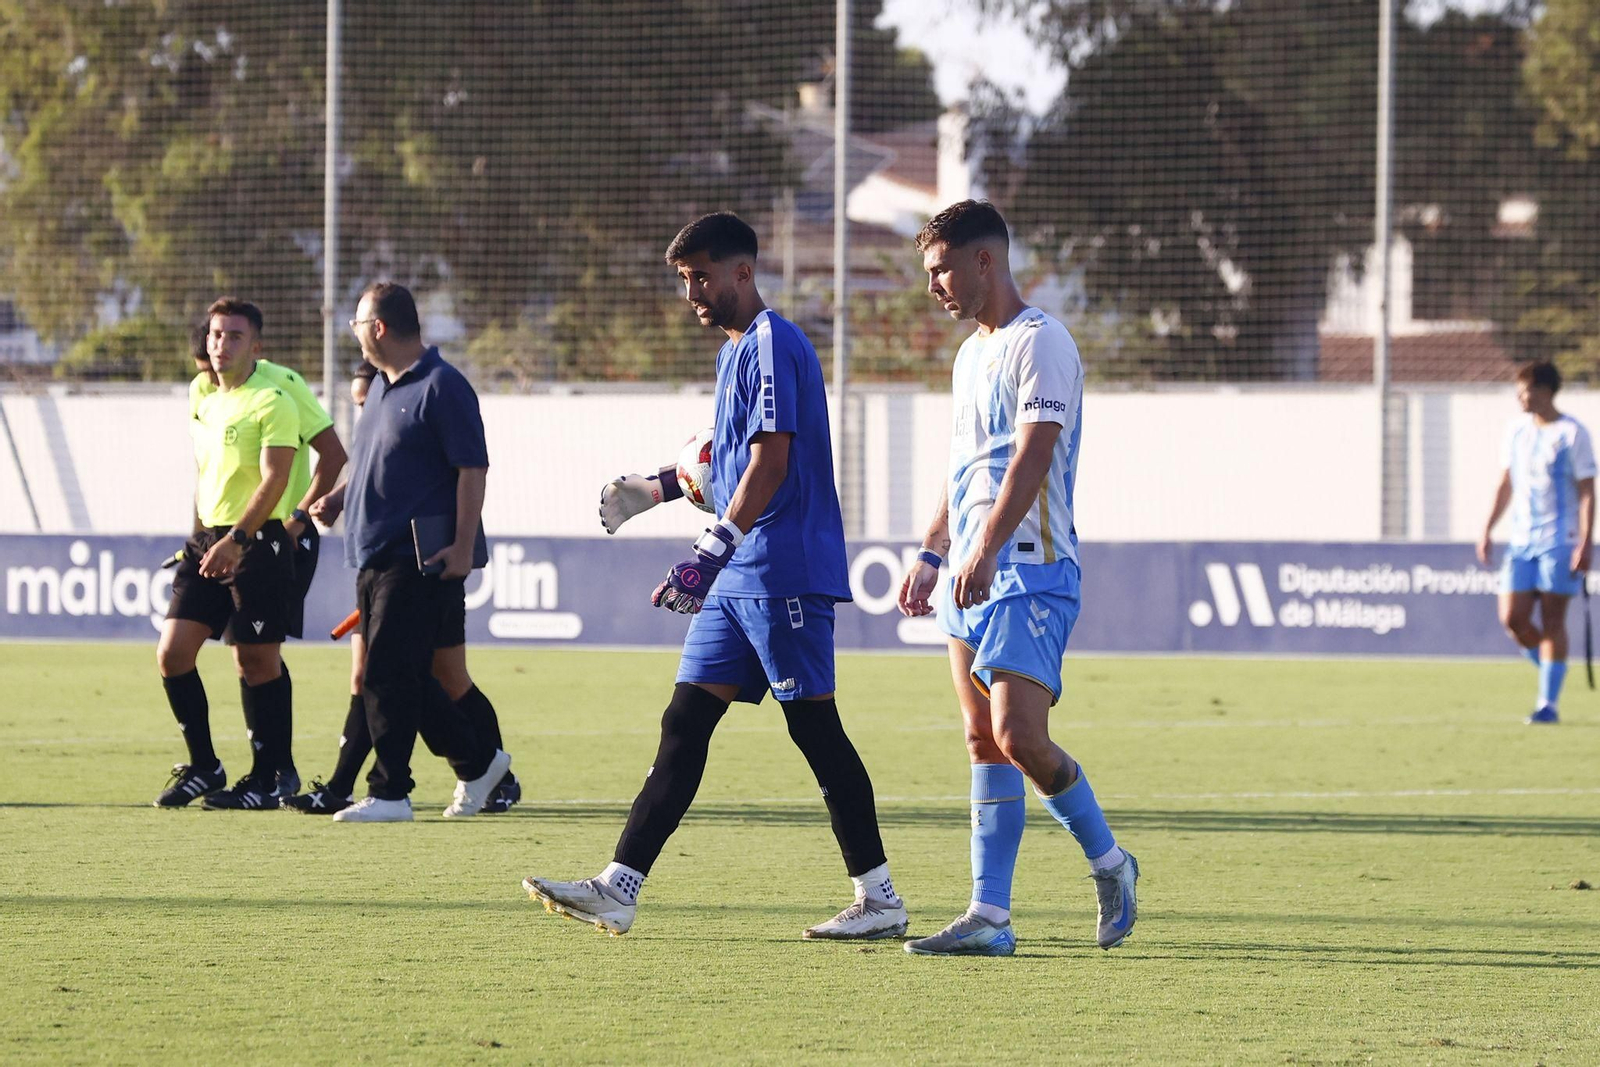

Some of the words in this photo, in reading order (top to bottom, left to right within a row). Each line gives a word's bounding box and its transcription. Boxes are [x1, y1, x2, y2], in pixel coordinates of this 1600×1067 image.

[6, 540, 175, 633] málag
[1278, 563, 1410, 598] Diputación
[1412, 564, 1502, 593] Provinc
[1279, 598, 1314, 628] de
[1315, 597, 1406, 635] Málaga
